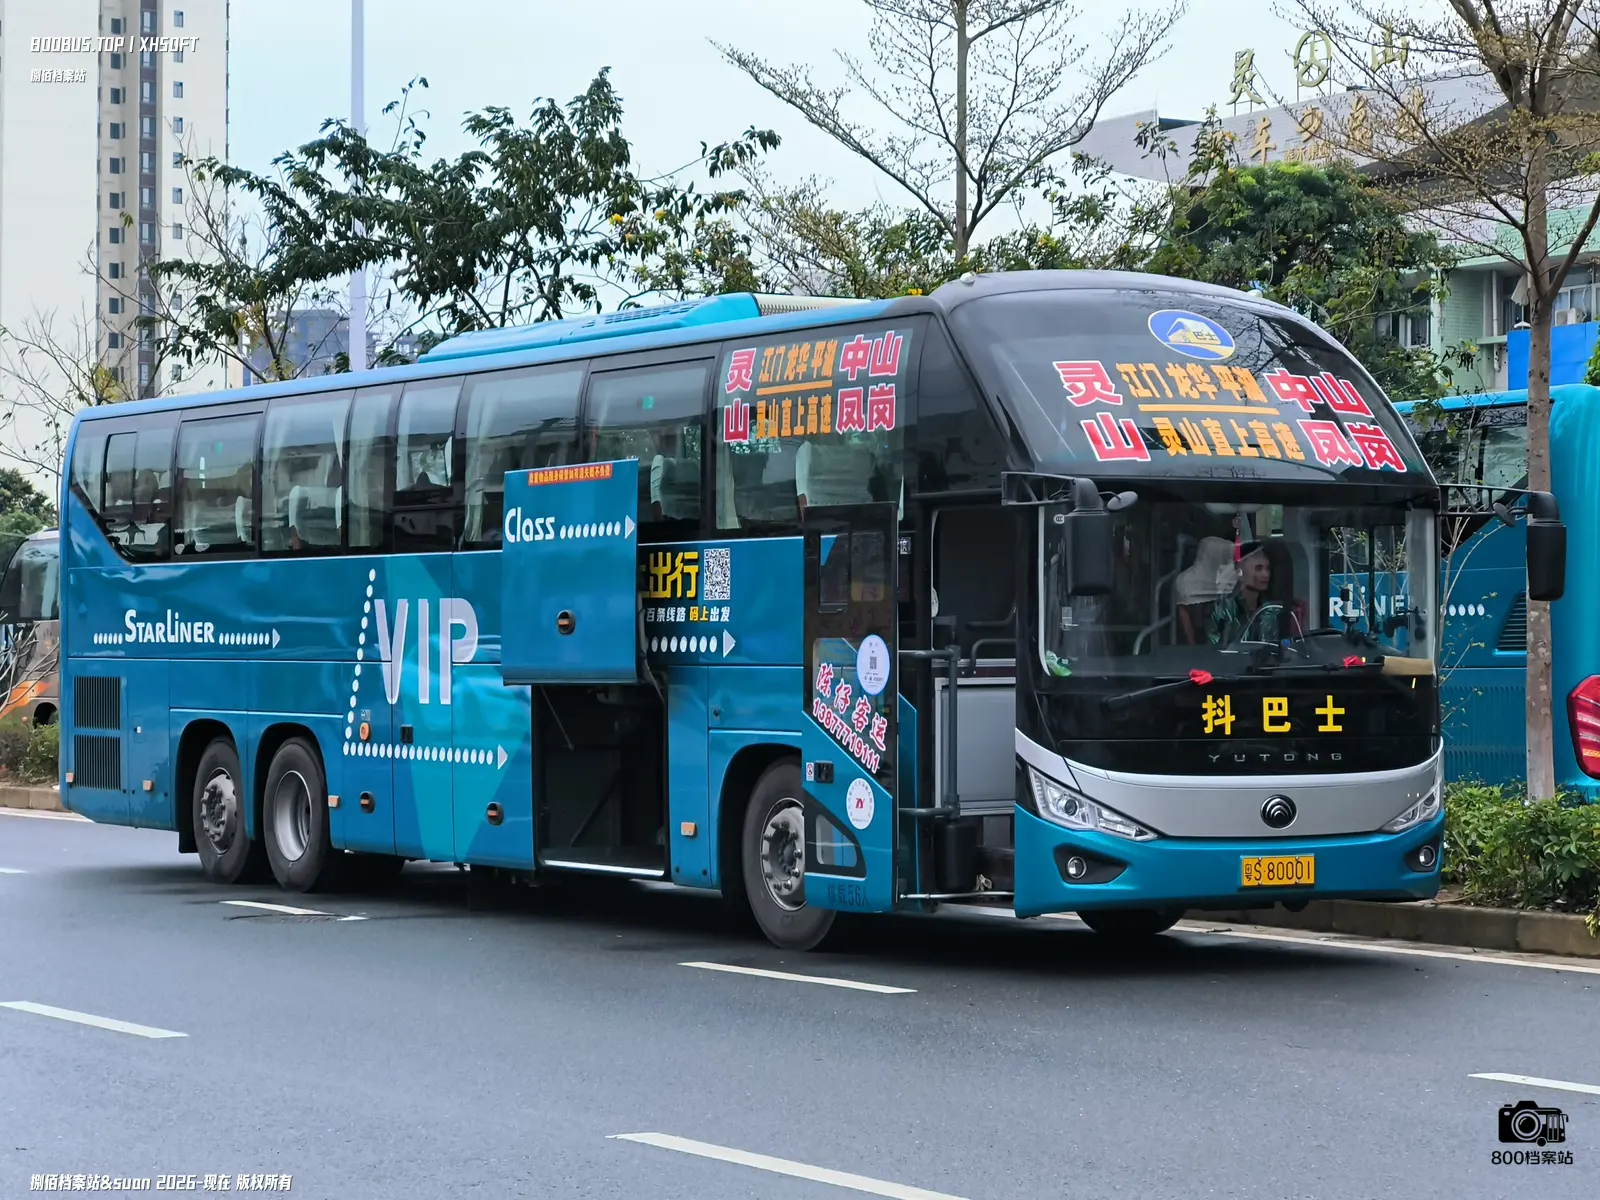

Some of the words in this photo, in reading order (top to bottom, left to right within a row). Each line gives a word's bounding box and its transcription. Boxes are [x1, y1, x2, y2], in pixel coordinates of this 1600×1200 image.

[838, 330, 903, 381] 中山
[835, 383, 896, 435] 凤岗
[1263, 368, 1375, 418] 中山
[1152, 417, 1306, 461] 灵山直上高速
[1297, 419, 1407, 473] 凤岗
[505, 507, 555, 543] Class
[375, 597, 478, 704] VIP
[1202, 695, 1346, 735] 抖巴士
[1208, 753, 1342, 763] YUTONG
